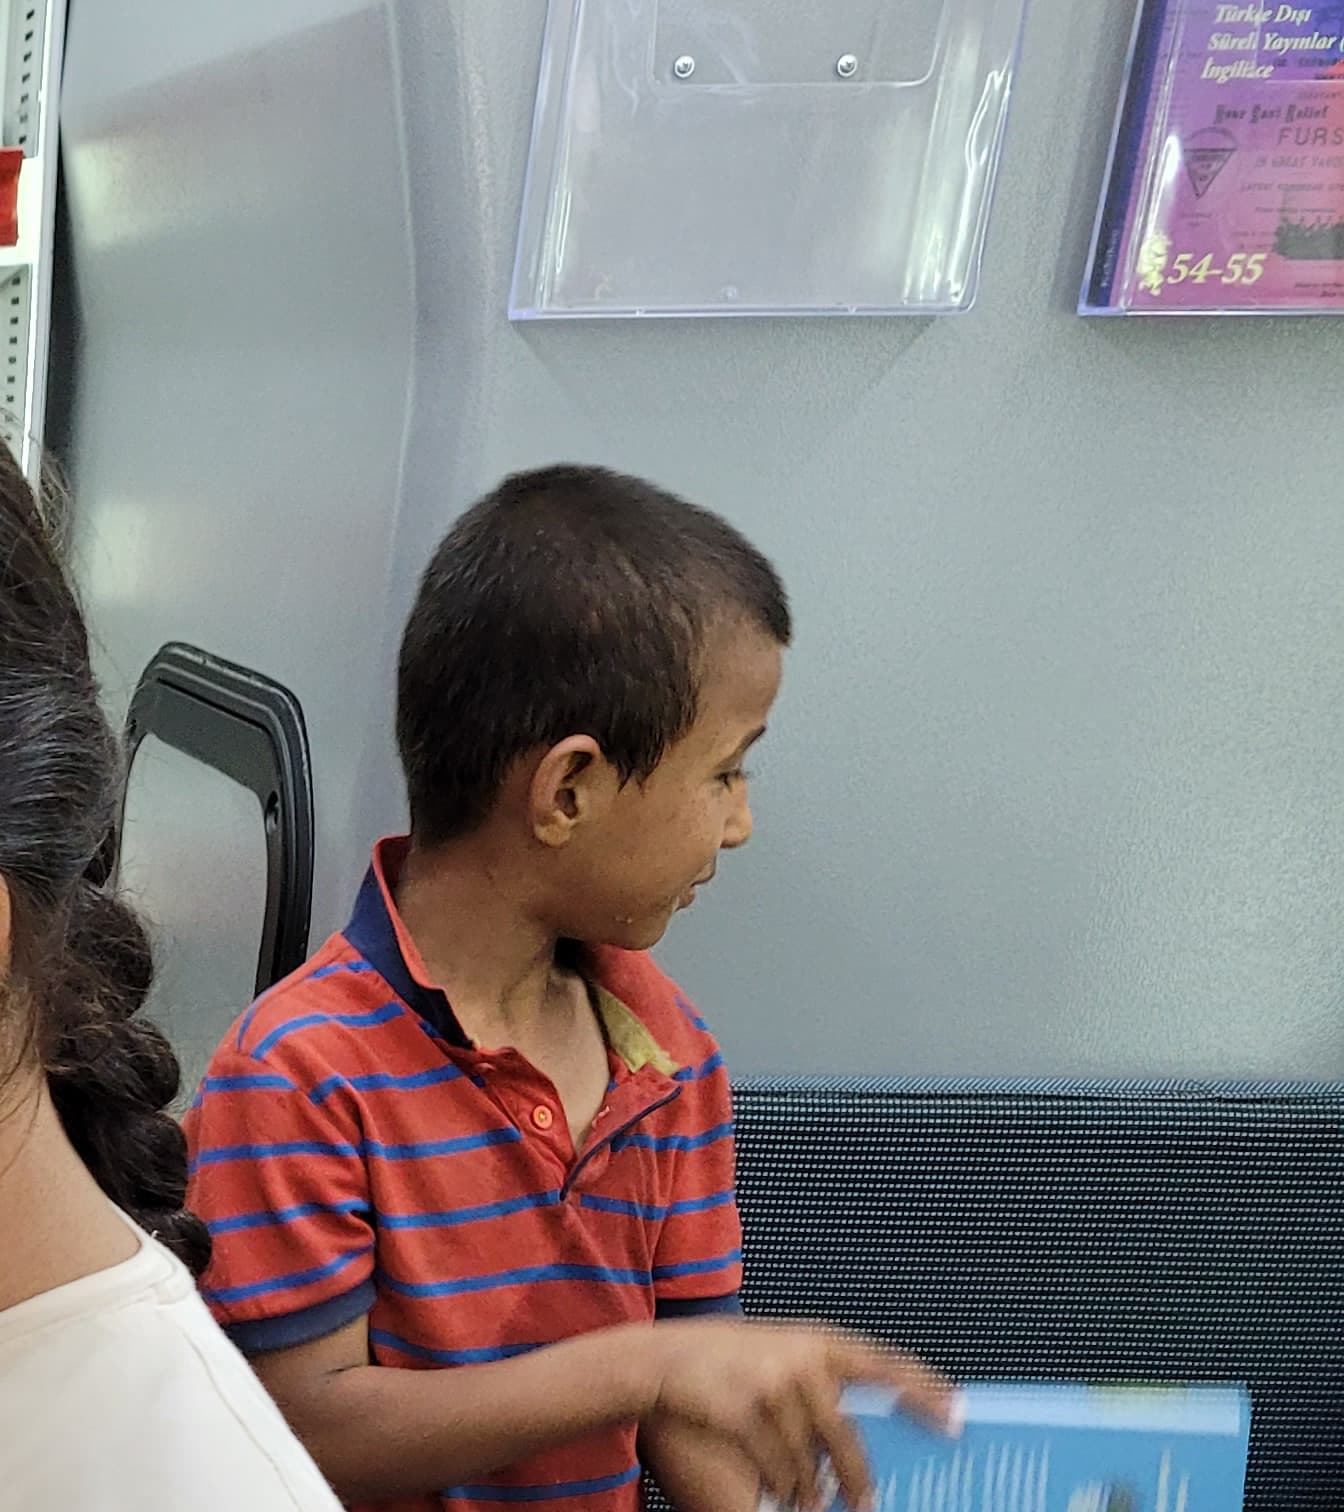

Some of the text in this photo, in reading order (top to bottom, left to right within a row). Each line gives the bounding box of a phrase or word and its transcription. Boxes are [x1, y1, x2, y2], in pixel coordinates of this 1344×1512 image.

[1215, 4, 1312, 26] Türkçe Dışı
[1208, 32, 1336, 55] Süreli Yayınlar
[1201, 57, 1274, 84] İngilizce
[1278, 127, 1344, 145] FURS
[1167, 253, 1266, 285] 54-55
